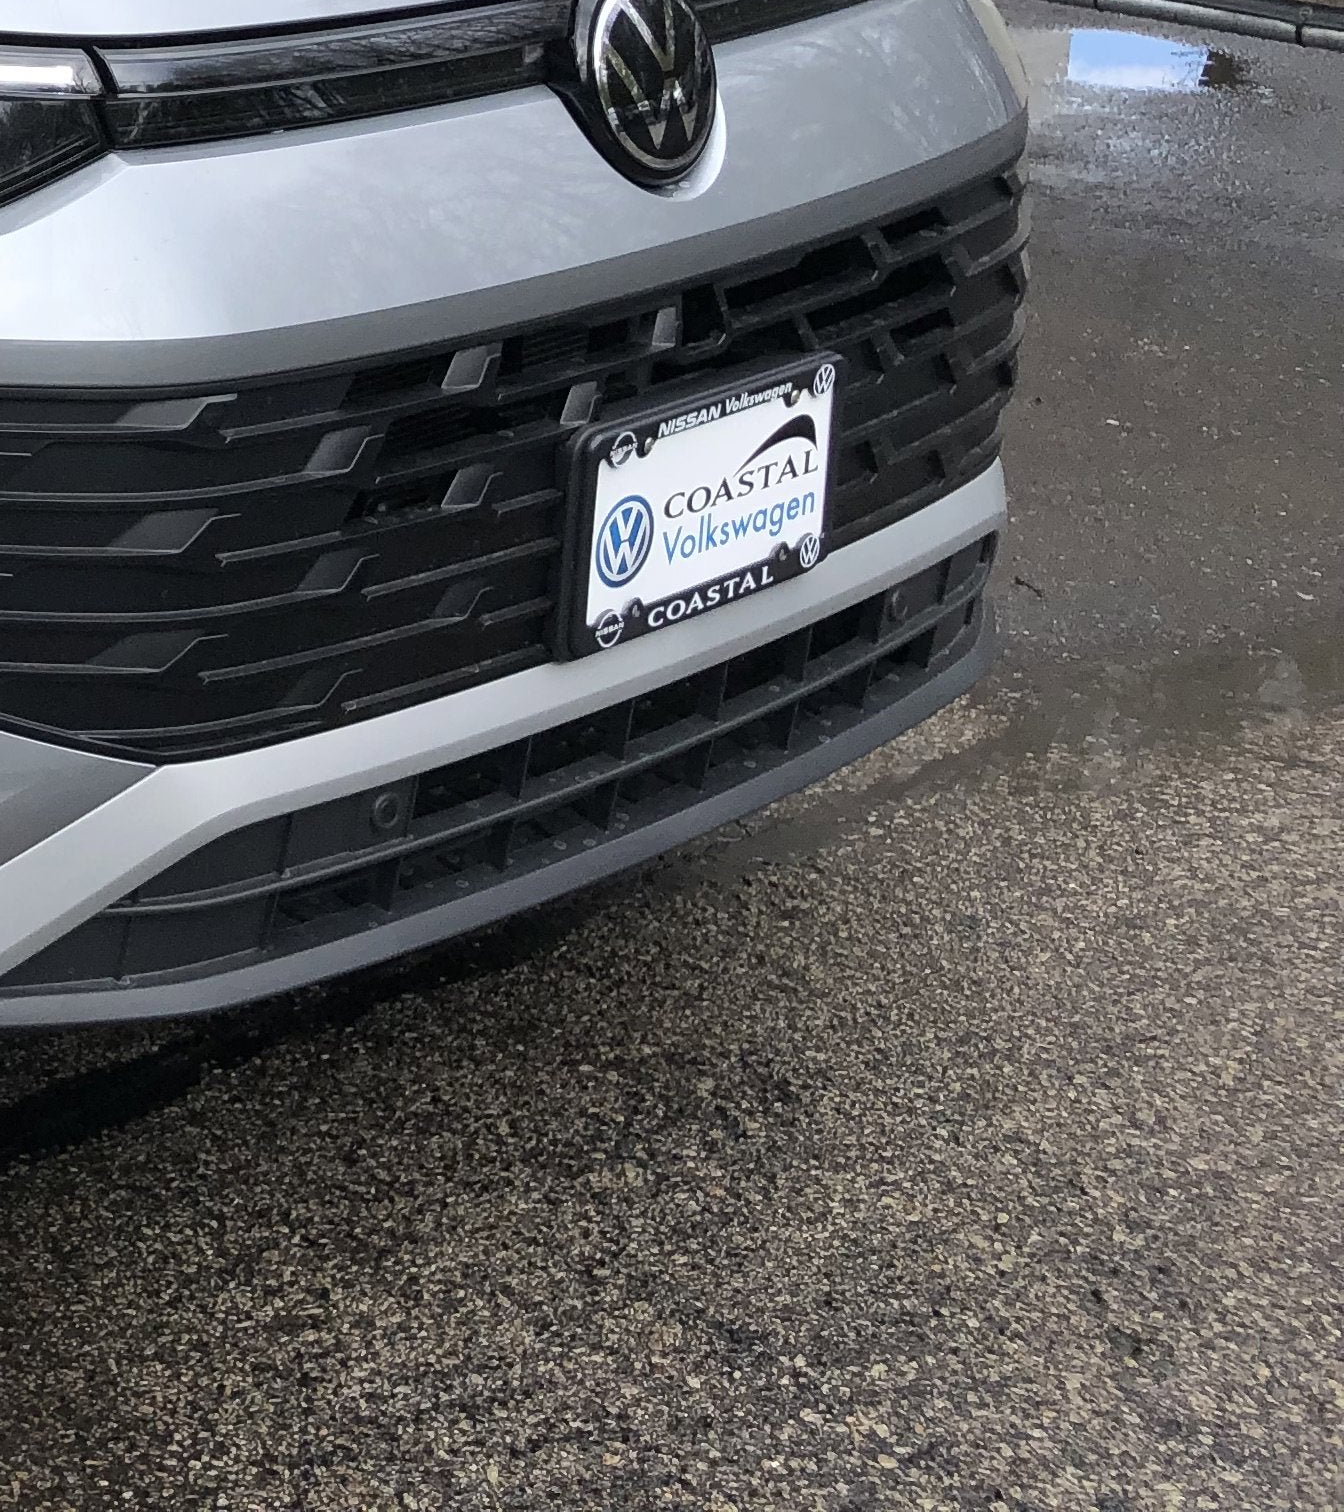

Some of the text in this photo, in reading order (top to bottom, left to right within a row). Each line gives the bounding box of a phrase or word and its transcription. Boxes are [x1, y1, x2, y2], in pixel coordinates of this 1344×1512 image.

[657, 381, 794, 439] NISSAN Volkswagen
[663, 449, 819, 520] COASTAL
[662, 491, 816, 565] Volkswagen
[647, 564, 774, 628] COASTAL
